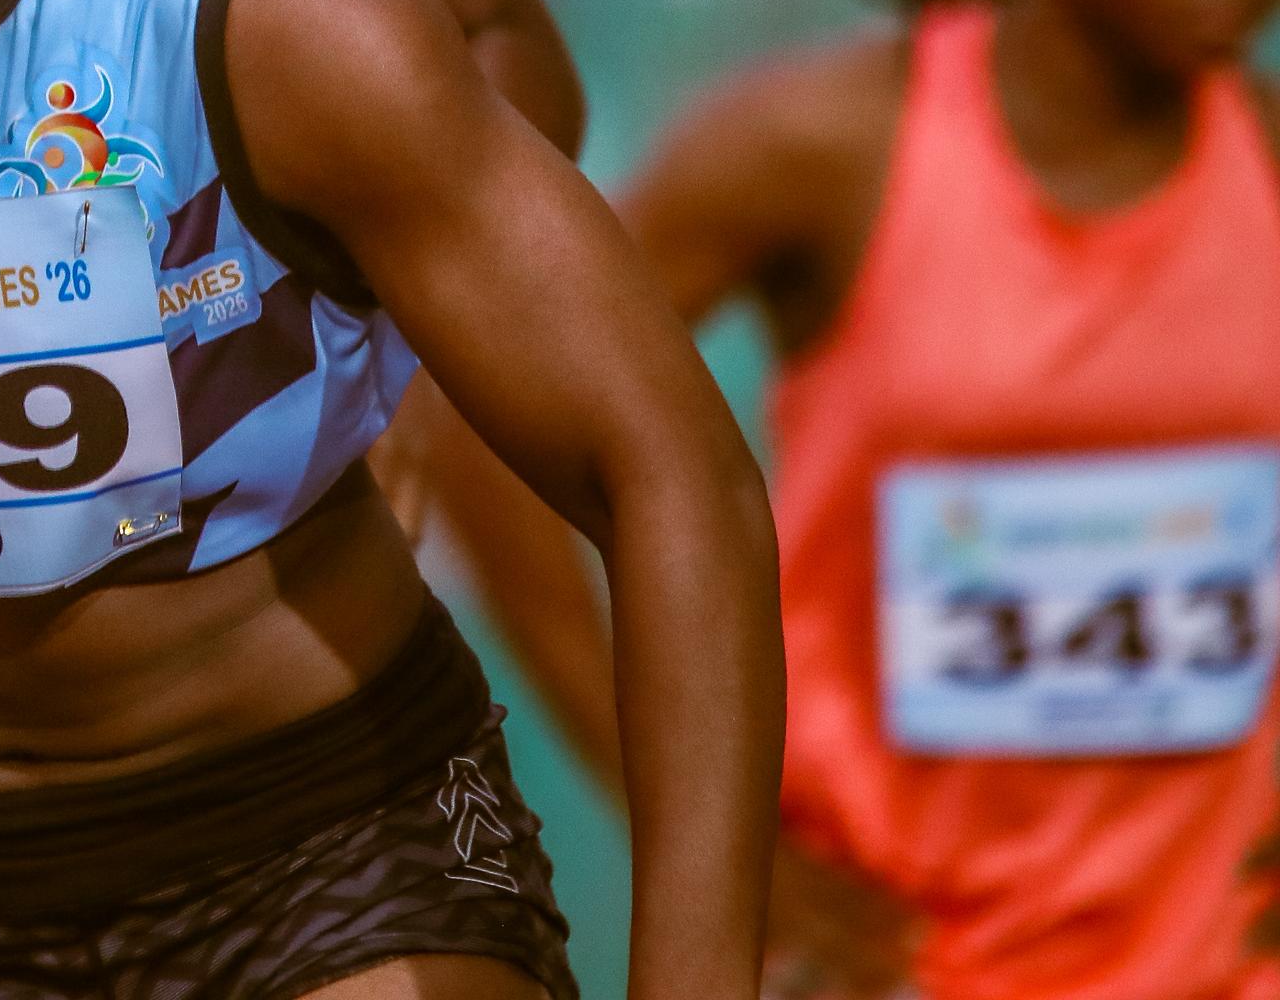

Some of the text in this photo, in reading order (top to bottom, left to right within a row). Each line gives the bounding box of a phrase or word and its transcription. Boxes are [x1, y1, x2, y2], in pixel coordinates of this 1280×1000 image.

[158, 261, 244, 319] AMES
[203, 291, 248, 326] 2026
[937, 568, 1256, 690] 343
